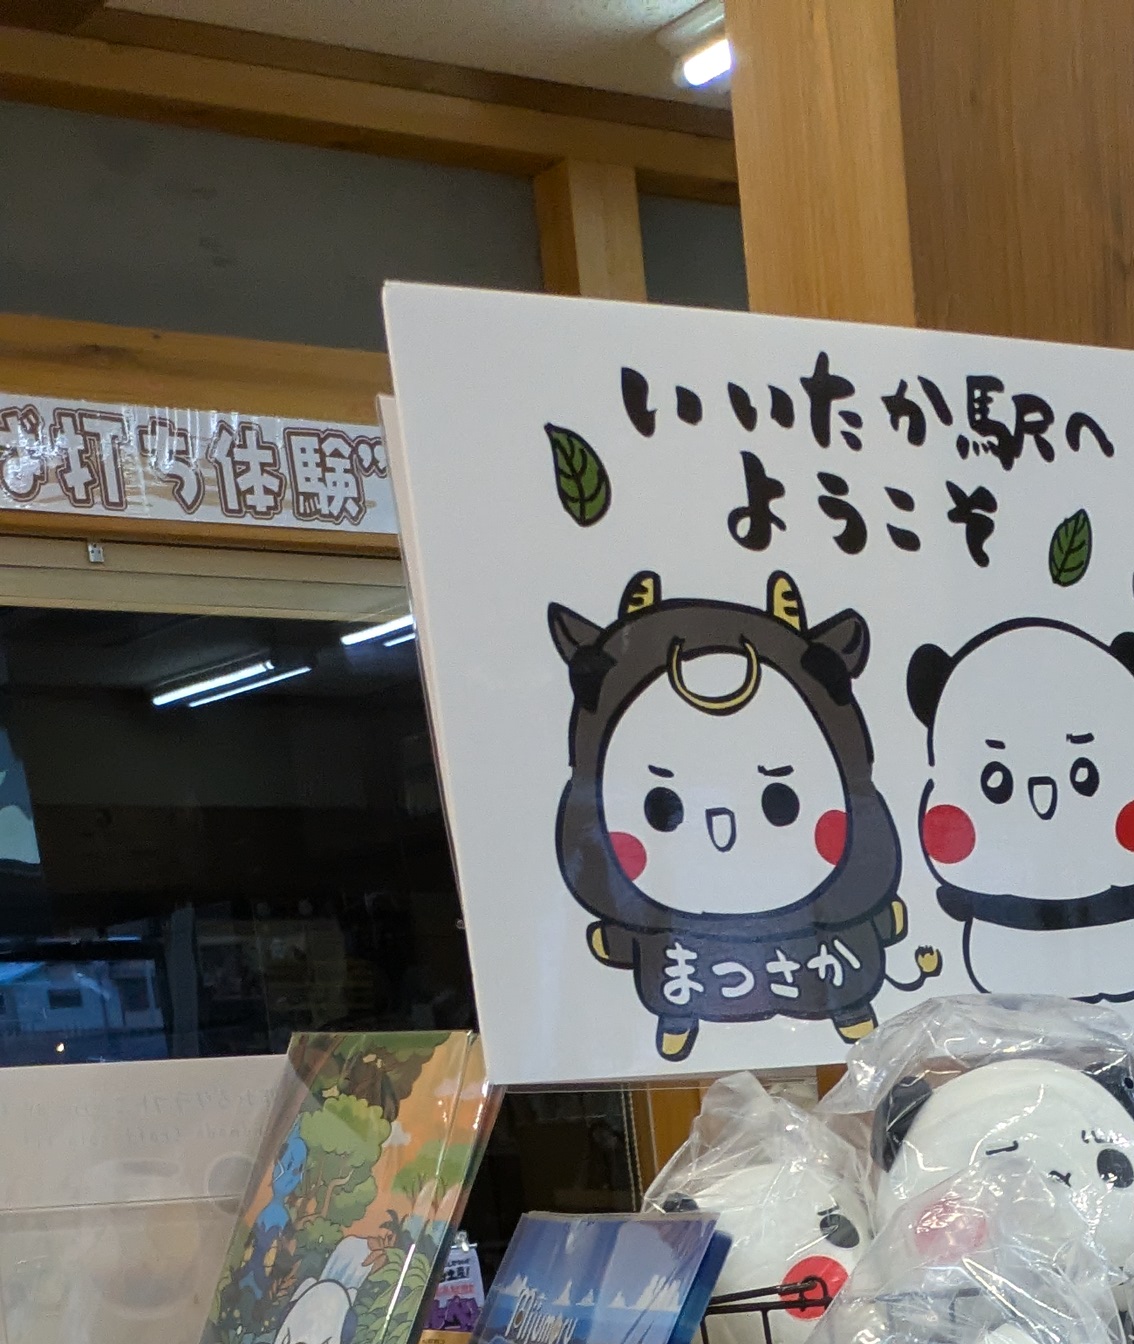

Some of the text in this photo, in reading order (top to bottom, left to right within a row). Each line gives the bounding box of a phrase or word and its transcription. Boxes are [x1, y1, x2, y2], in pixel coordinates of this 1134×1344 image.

[621, 352, 1114, 472] いいたか駅へ
[727, 451, 1000, 566] ようこそ
[662, 940, 862, 1005] まつさか
